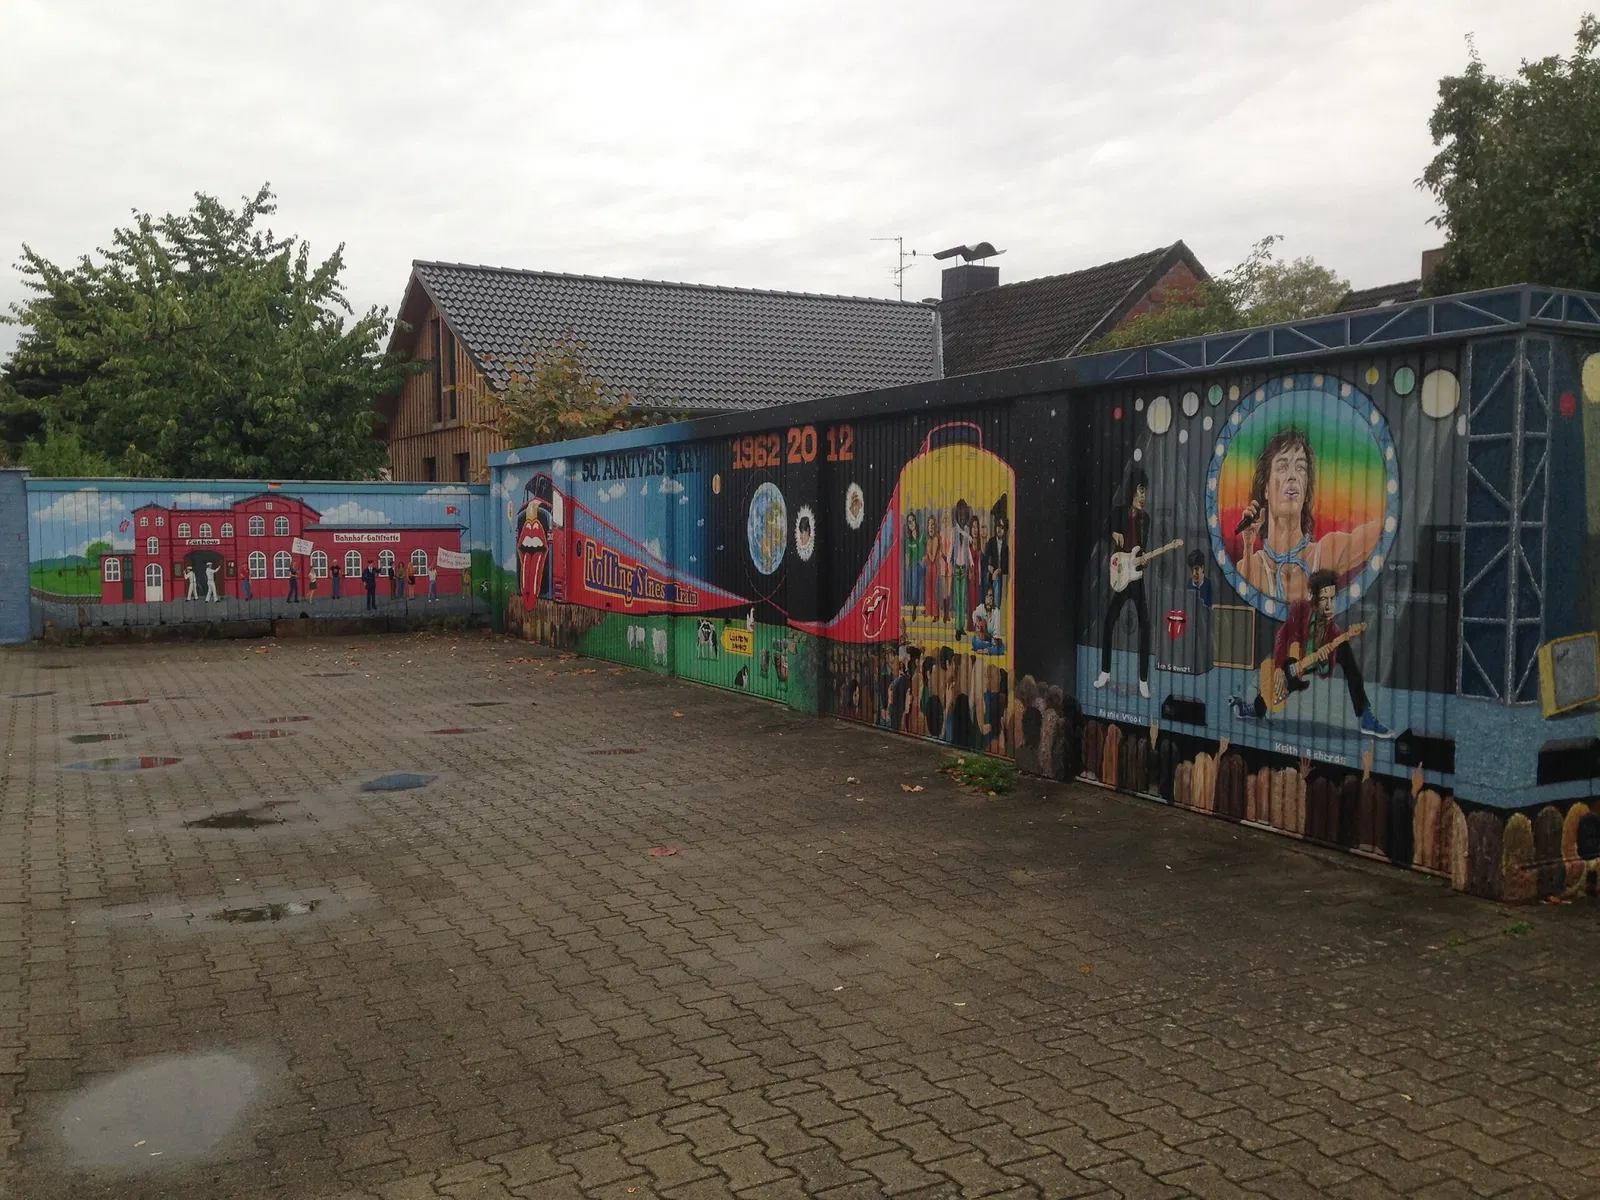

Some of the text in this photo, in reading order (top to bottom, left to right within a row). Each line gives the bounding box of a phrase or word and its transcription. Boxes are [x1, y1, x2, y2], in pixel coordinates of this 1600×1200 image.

[732, 433, 781, 470] 1962
[586, 545, 698, 605] Rolling Stnes Train
[1275, 742, 1298, 755] Keith
